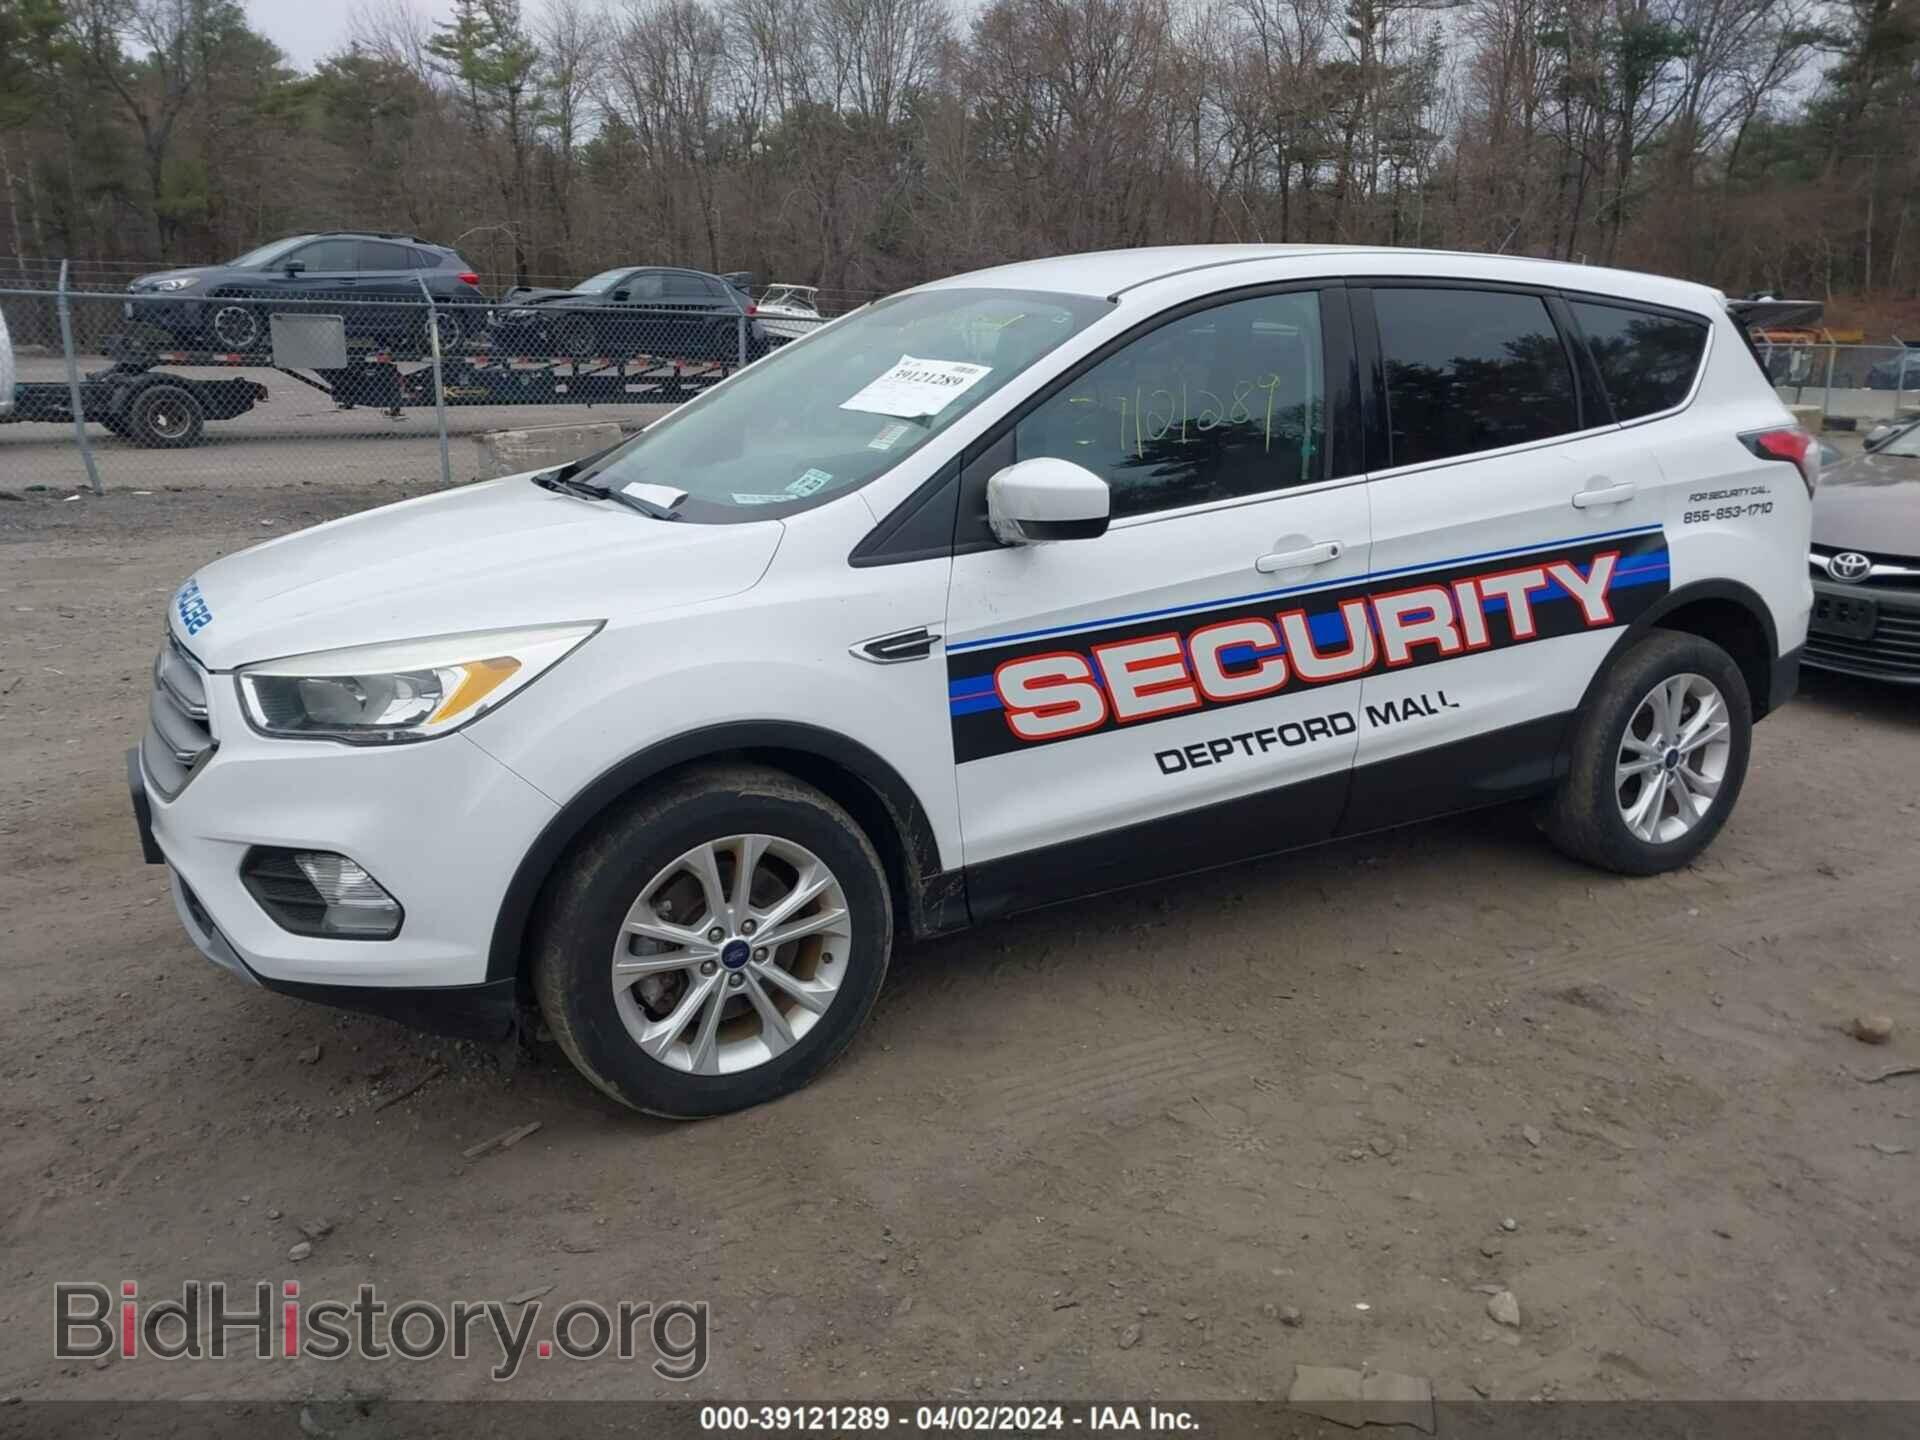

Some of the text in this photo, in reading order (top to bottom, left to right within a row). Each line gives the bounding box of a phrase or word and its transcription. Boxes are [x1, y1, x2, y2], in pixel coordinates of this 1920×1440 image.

[996, 550, 1620, 741] SECURITY
[1154, 690, 1460, 775] DEPTFORD MALL
